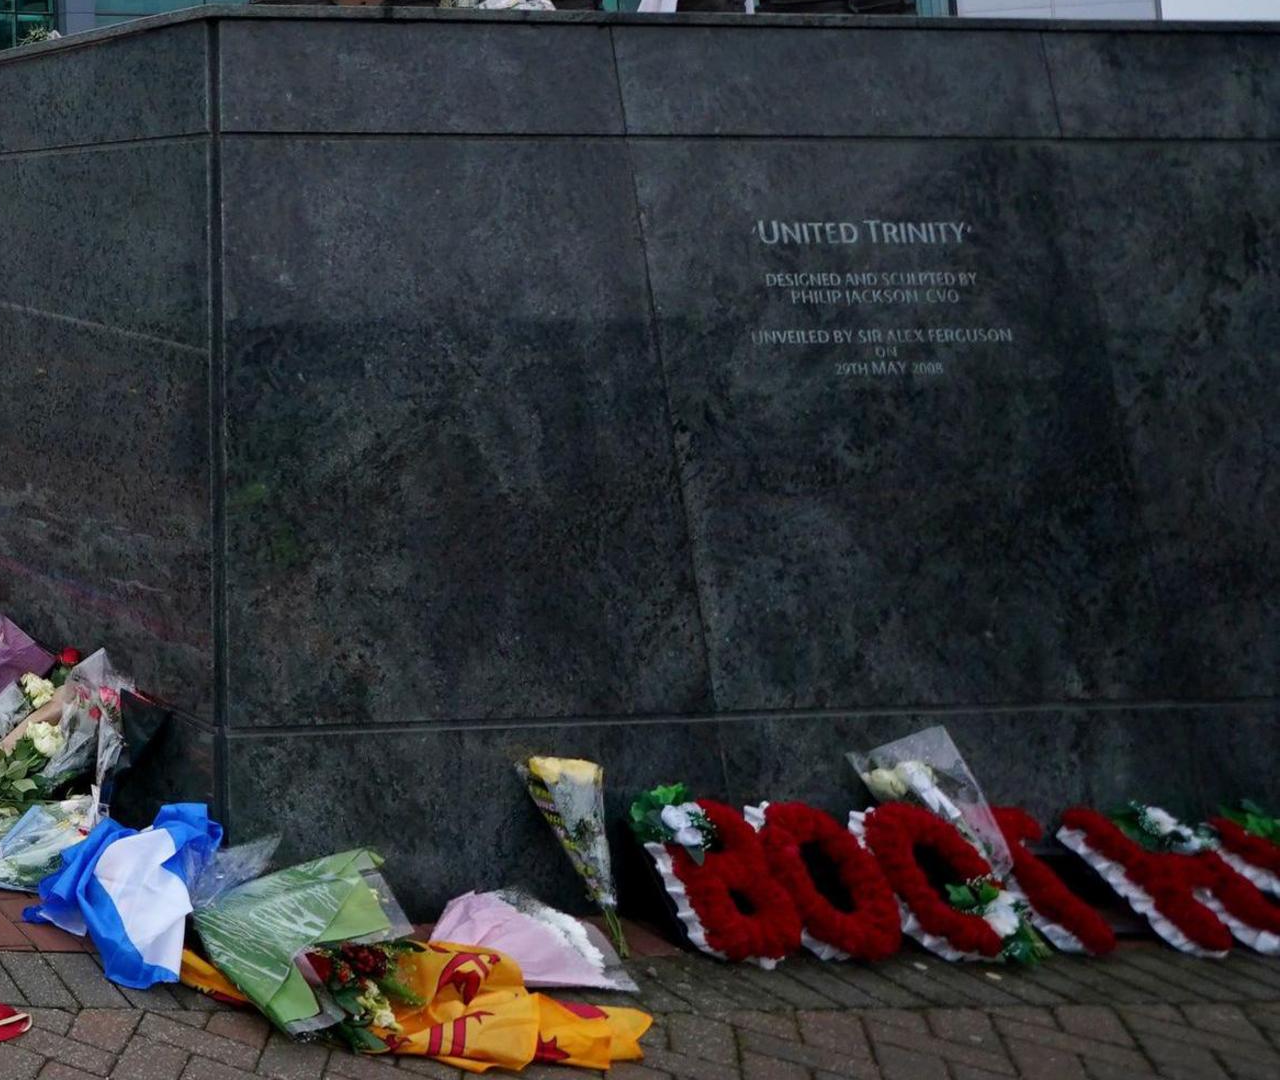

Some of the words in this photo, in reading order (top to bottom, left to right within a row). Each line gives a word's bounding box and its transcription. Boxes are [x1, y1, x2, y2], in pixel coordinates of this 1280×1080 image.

[765, 272, 841, 288] DESIGNED
[845, 273, 878, 287] AND
[881, 272, 956, 288] SCULPTED
[959, 272, 978, 287] BY
[791, 289, 841, 304] PHILIP
[845, 289, 920, 306] JACKSON
[925, 290, 960, 304] CVO
[751, 329, 830, 345] UNVEILED
[833, 330, 853, 344] BY
[857, 329, 883, 344] SIR
[886, 329, 925, 344] ALEX
[928, 328, 1013, 343] FERGUSON
[834, 360, 869, 376] 29TH
[871, 360, 907, 375] MAY
